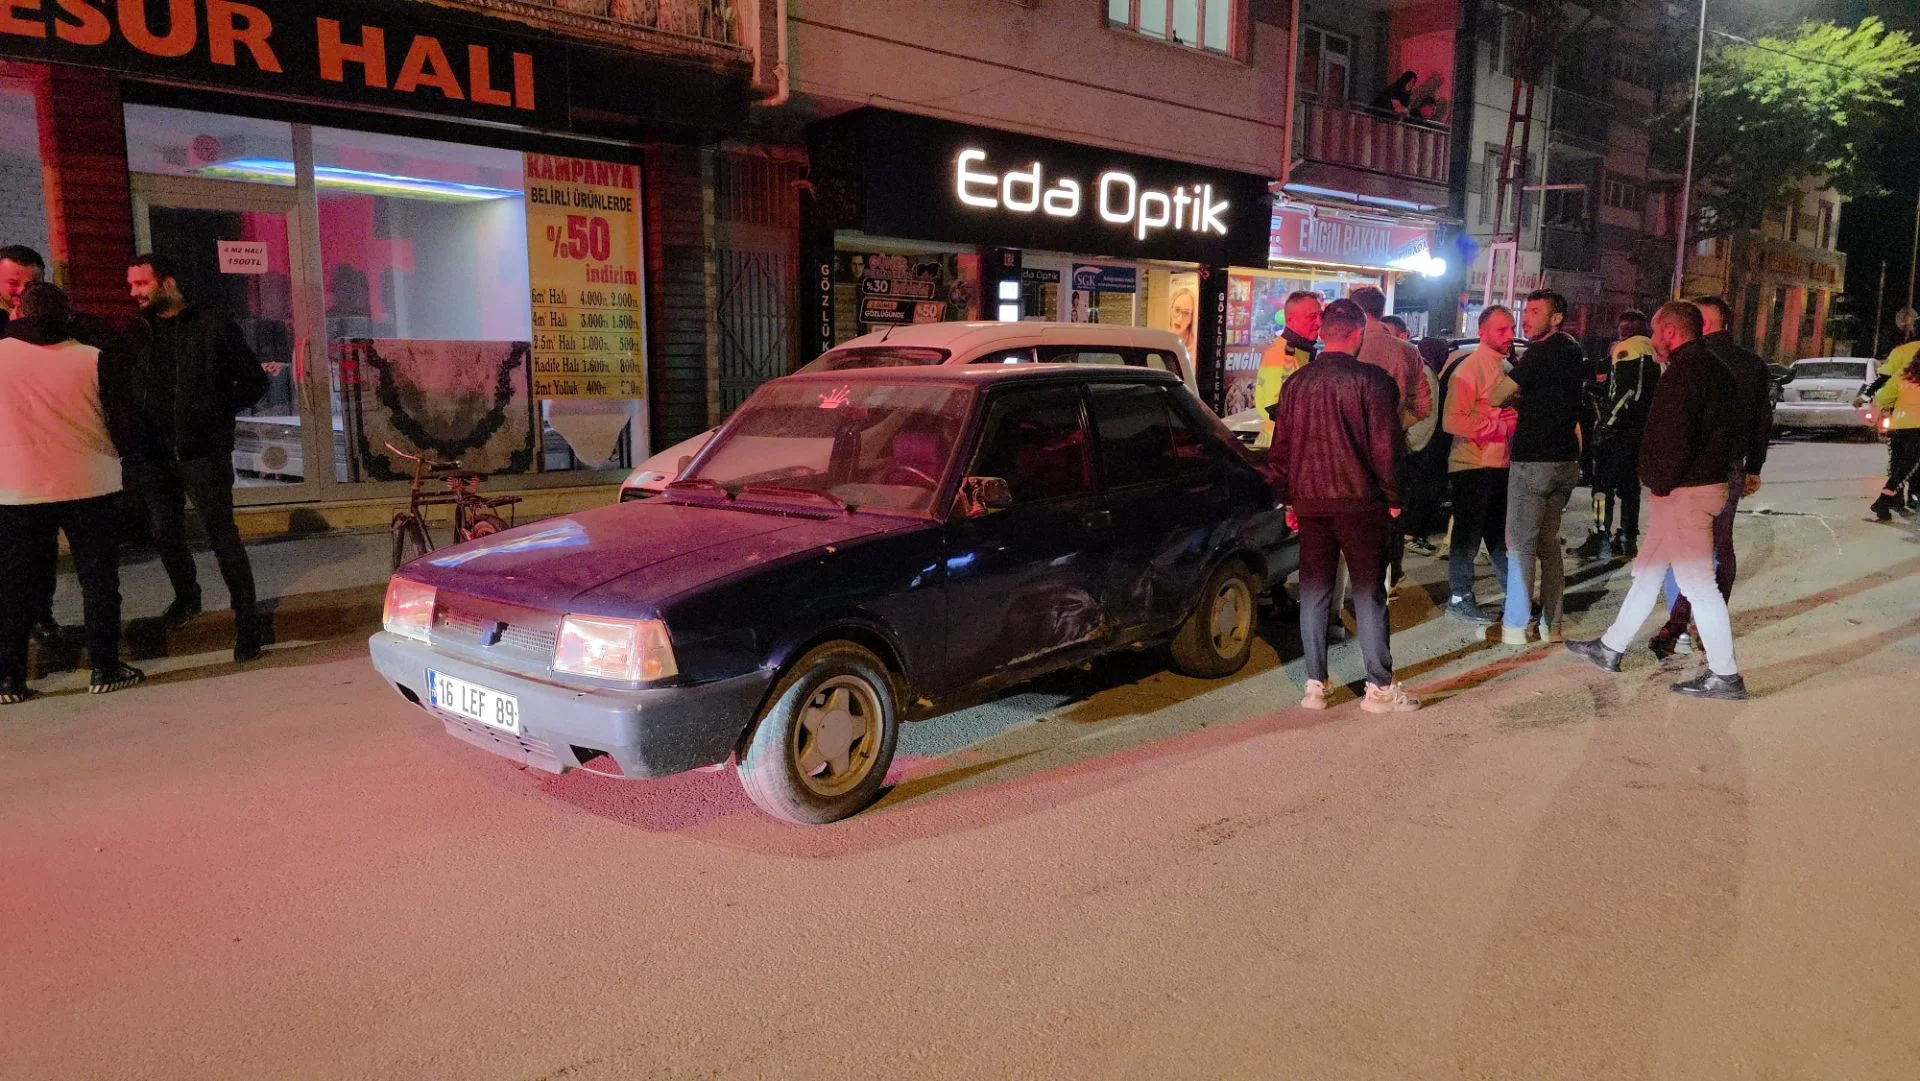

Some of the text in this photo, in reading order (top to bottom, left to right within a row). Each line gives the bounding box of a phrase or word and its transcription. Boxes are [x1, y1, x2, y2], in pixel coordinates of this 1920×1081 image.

[316, 17, 535, 110] HALI
[527, 153, 634, 189] KAMPANYA
[531, 185, 632, 212] BELİRLİ ÜRÜNLERDE
[957, 149, 1229, 241] Eda Optik
[546, 214, 610, 261] %50
[586, 263, 638, 285] indirim
[1077, 275, 1097, 287] SGK
[549, 288, 567, 305] Halı
[866, 280, 888, 293] %30
[550, 312, 567, 328] Halı
[820, 264, 830, 352] GÖZLÜK
[1216, 292, 1225, 357] GÖZLÜK
[559, 335, 576, 351] Halı
[535, 357, 560, 372] Kadife
[562, 358, 579, 373] Halı
[554, 380, 578, 396] Yolluk
[439, 679, 514, 727] 16 LEF 89
